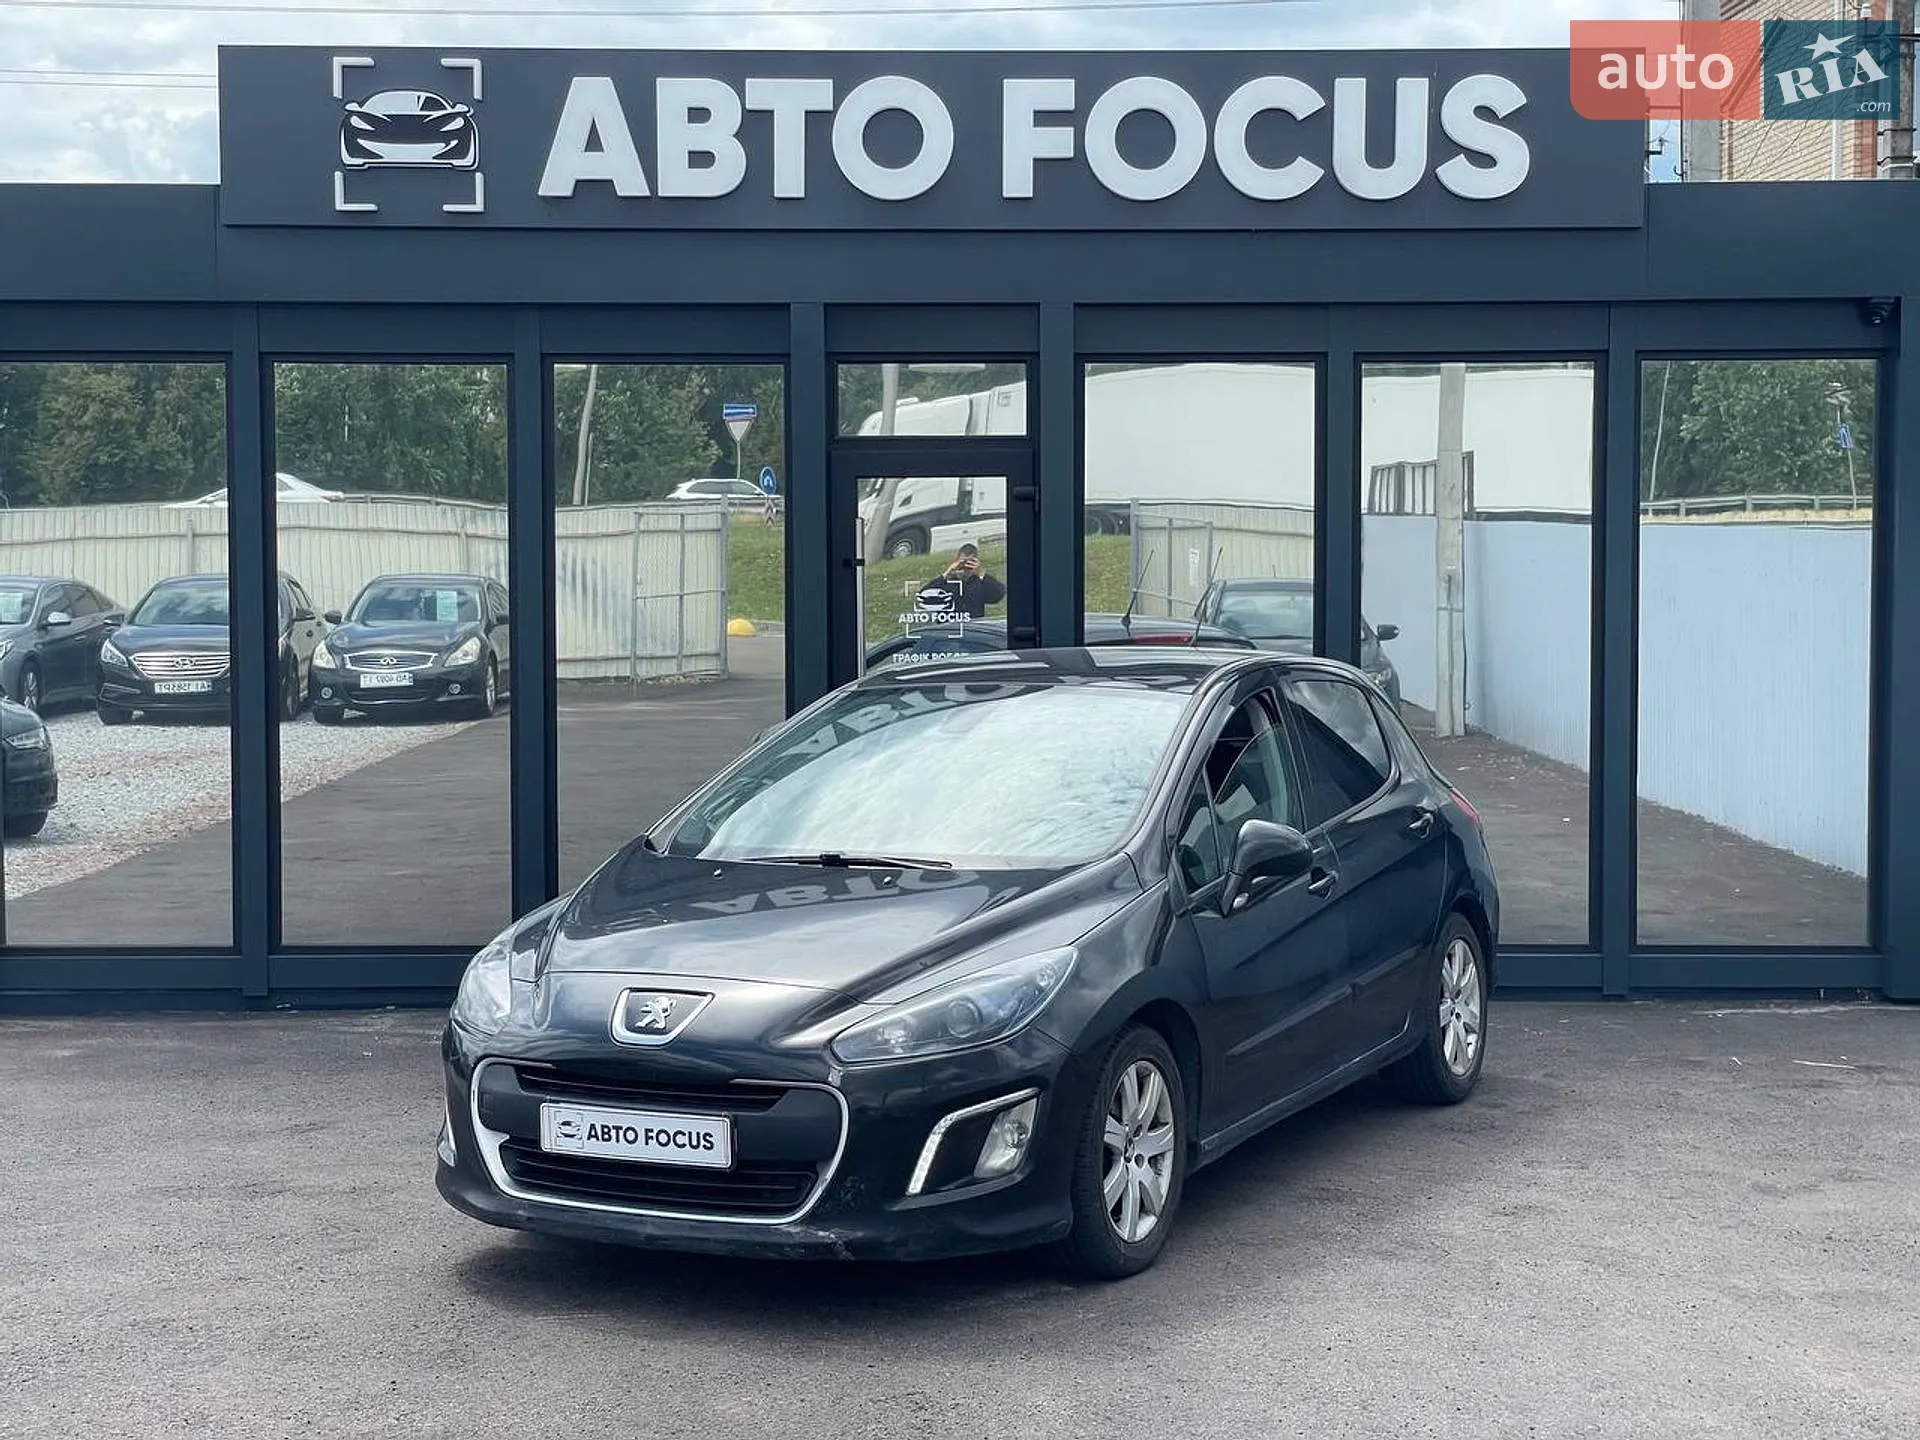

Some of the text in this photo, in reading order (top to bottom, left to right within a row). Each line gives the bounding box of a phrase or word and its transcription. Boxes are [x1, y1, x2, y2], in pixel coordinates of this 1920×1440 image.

[537, 73, 1531, 201] АВТО FOCUS
[898, 612, 971, 624] АВТО FOCUS
[586, 1123, 715, 1151] АВТО FOCUS
